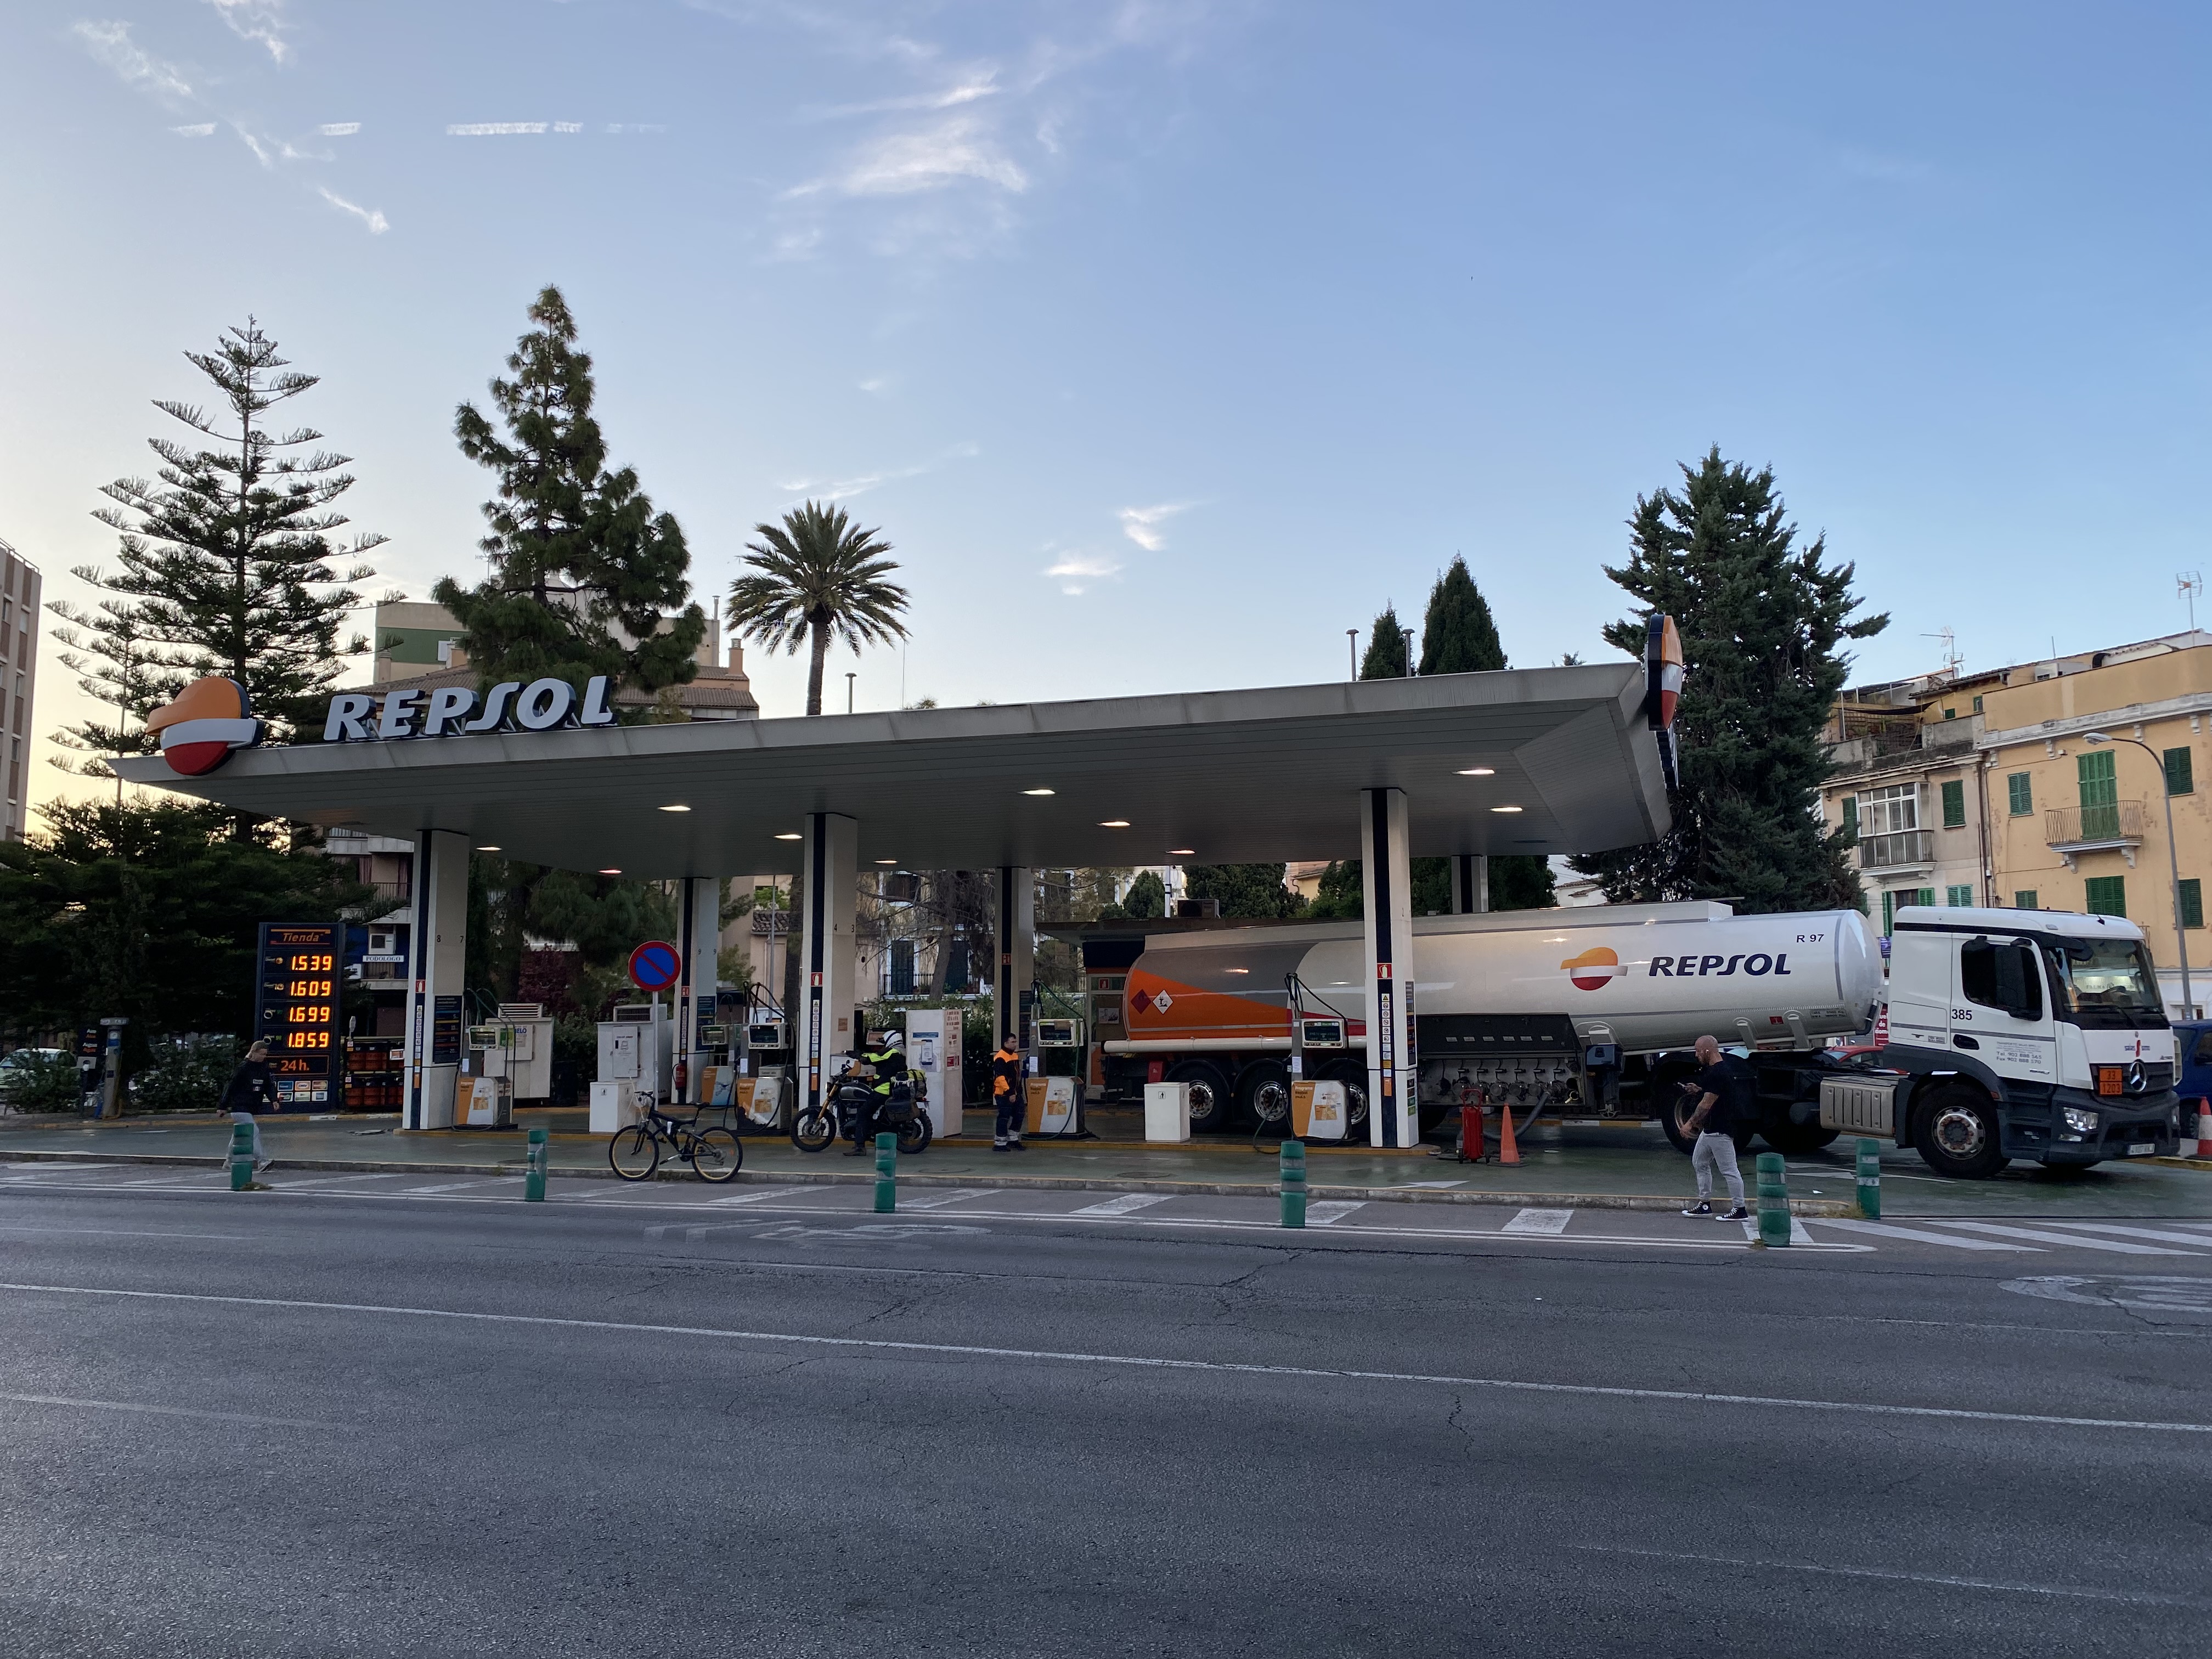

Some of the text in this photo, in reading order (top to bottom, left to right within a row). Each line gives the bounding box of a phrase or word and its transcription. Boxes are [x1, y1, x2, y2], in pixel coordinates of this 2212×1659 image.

[324, 675, 618, 742] REPSOL
[851, 924, 855, 933] 3
[283, 933, 319, 942] Tienda
[437, 934, 441, 943] 8
[460, 935, 464, 944] 7
[1796, 934, 1825, 943] R 97
[291, 956, 332, 970] 1.539
[1649, 953, 1791, 977] REPSOL
[290, 981, 331, 996] 1.609
[289, 1007, 330, 1022] 1.699
[1951, 1008, 1973, 1021] 385
[288, 1032, 329, 1048] 1.859
[280, 1060, 297, 1071] 24
[298, 1059, 310, 1071] h.
[2107, 1070, 2115, 1080] 33
[2102, 1084, 2121, 1093] 1203
